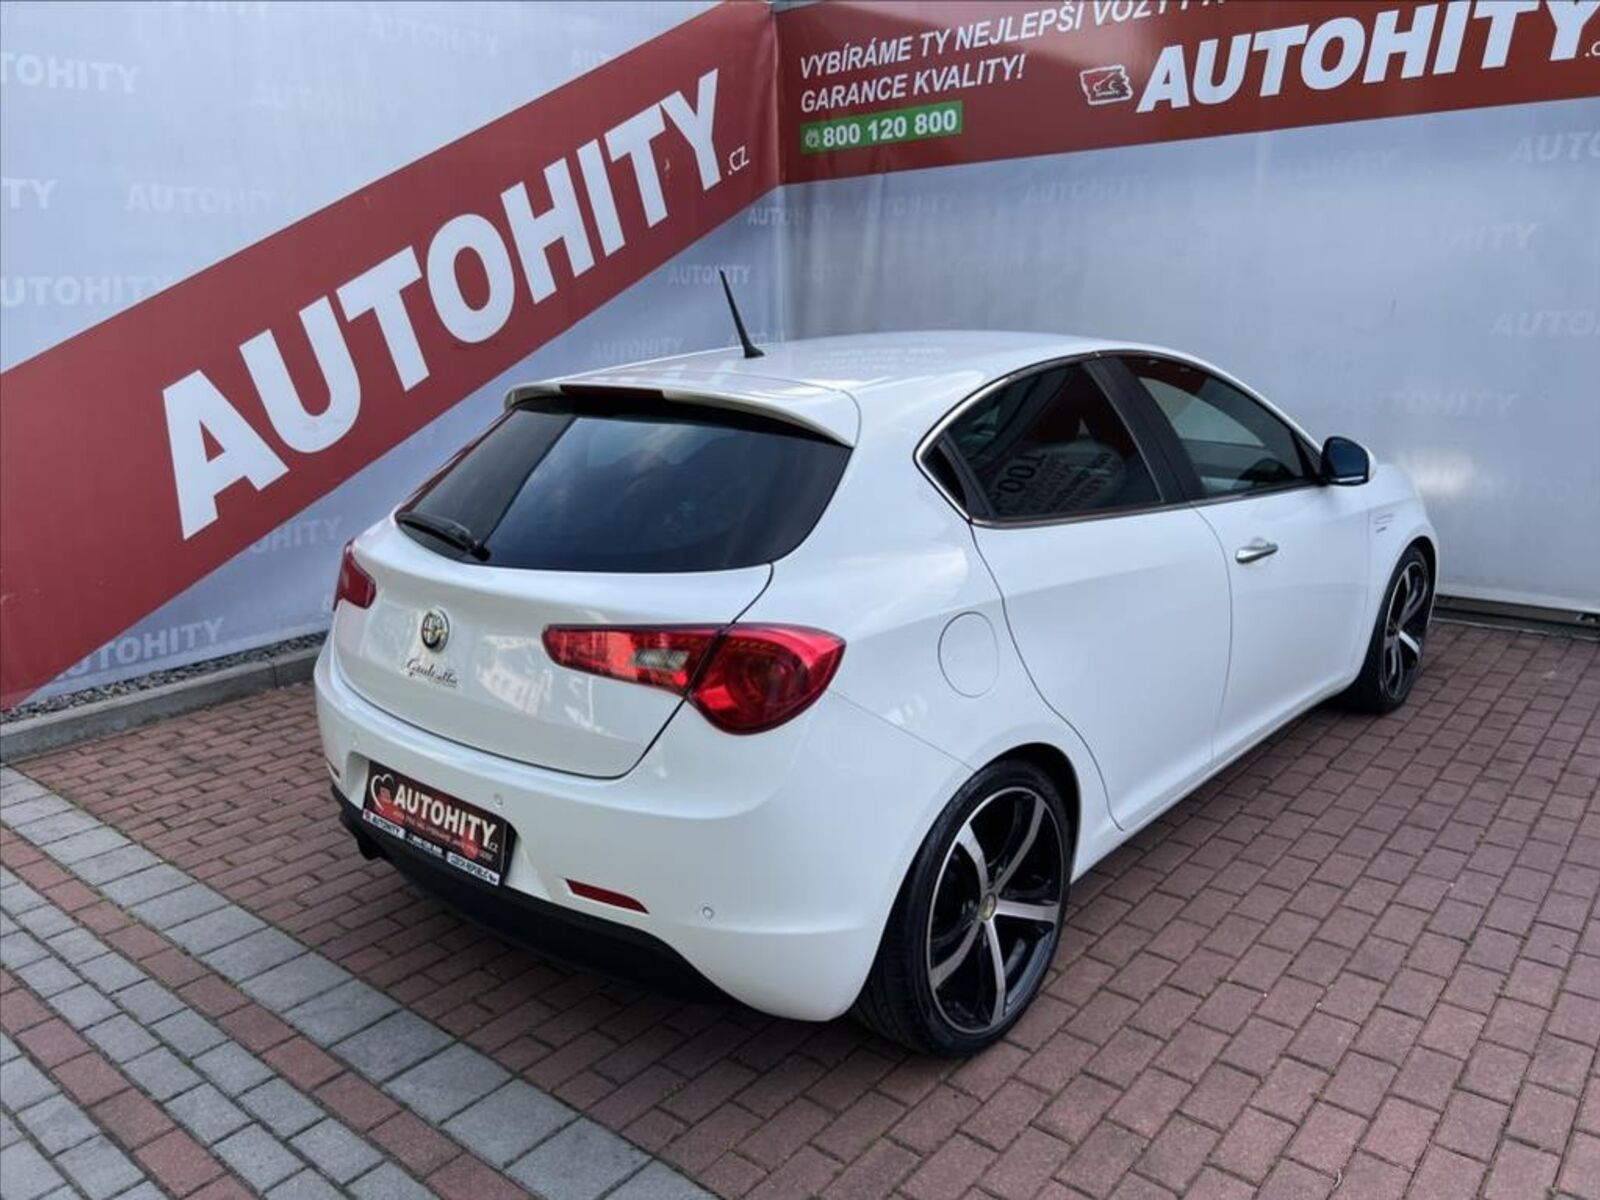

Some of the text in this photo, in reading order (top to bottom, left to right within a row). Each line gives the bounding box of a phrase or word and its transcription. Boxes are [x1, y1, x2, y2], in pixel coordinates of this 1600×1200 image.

[800, 37, 913, 79] VYBÍRÁME
[920, 29, 951, 57] TY
[801, 53, 1026, 113] GARANCE KVALITY!
[822, 109, 958, 148] 800 120 800
